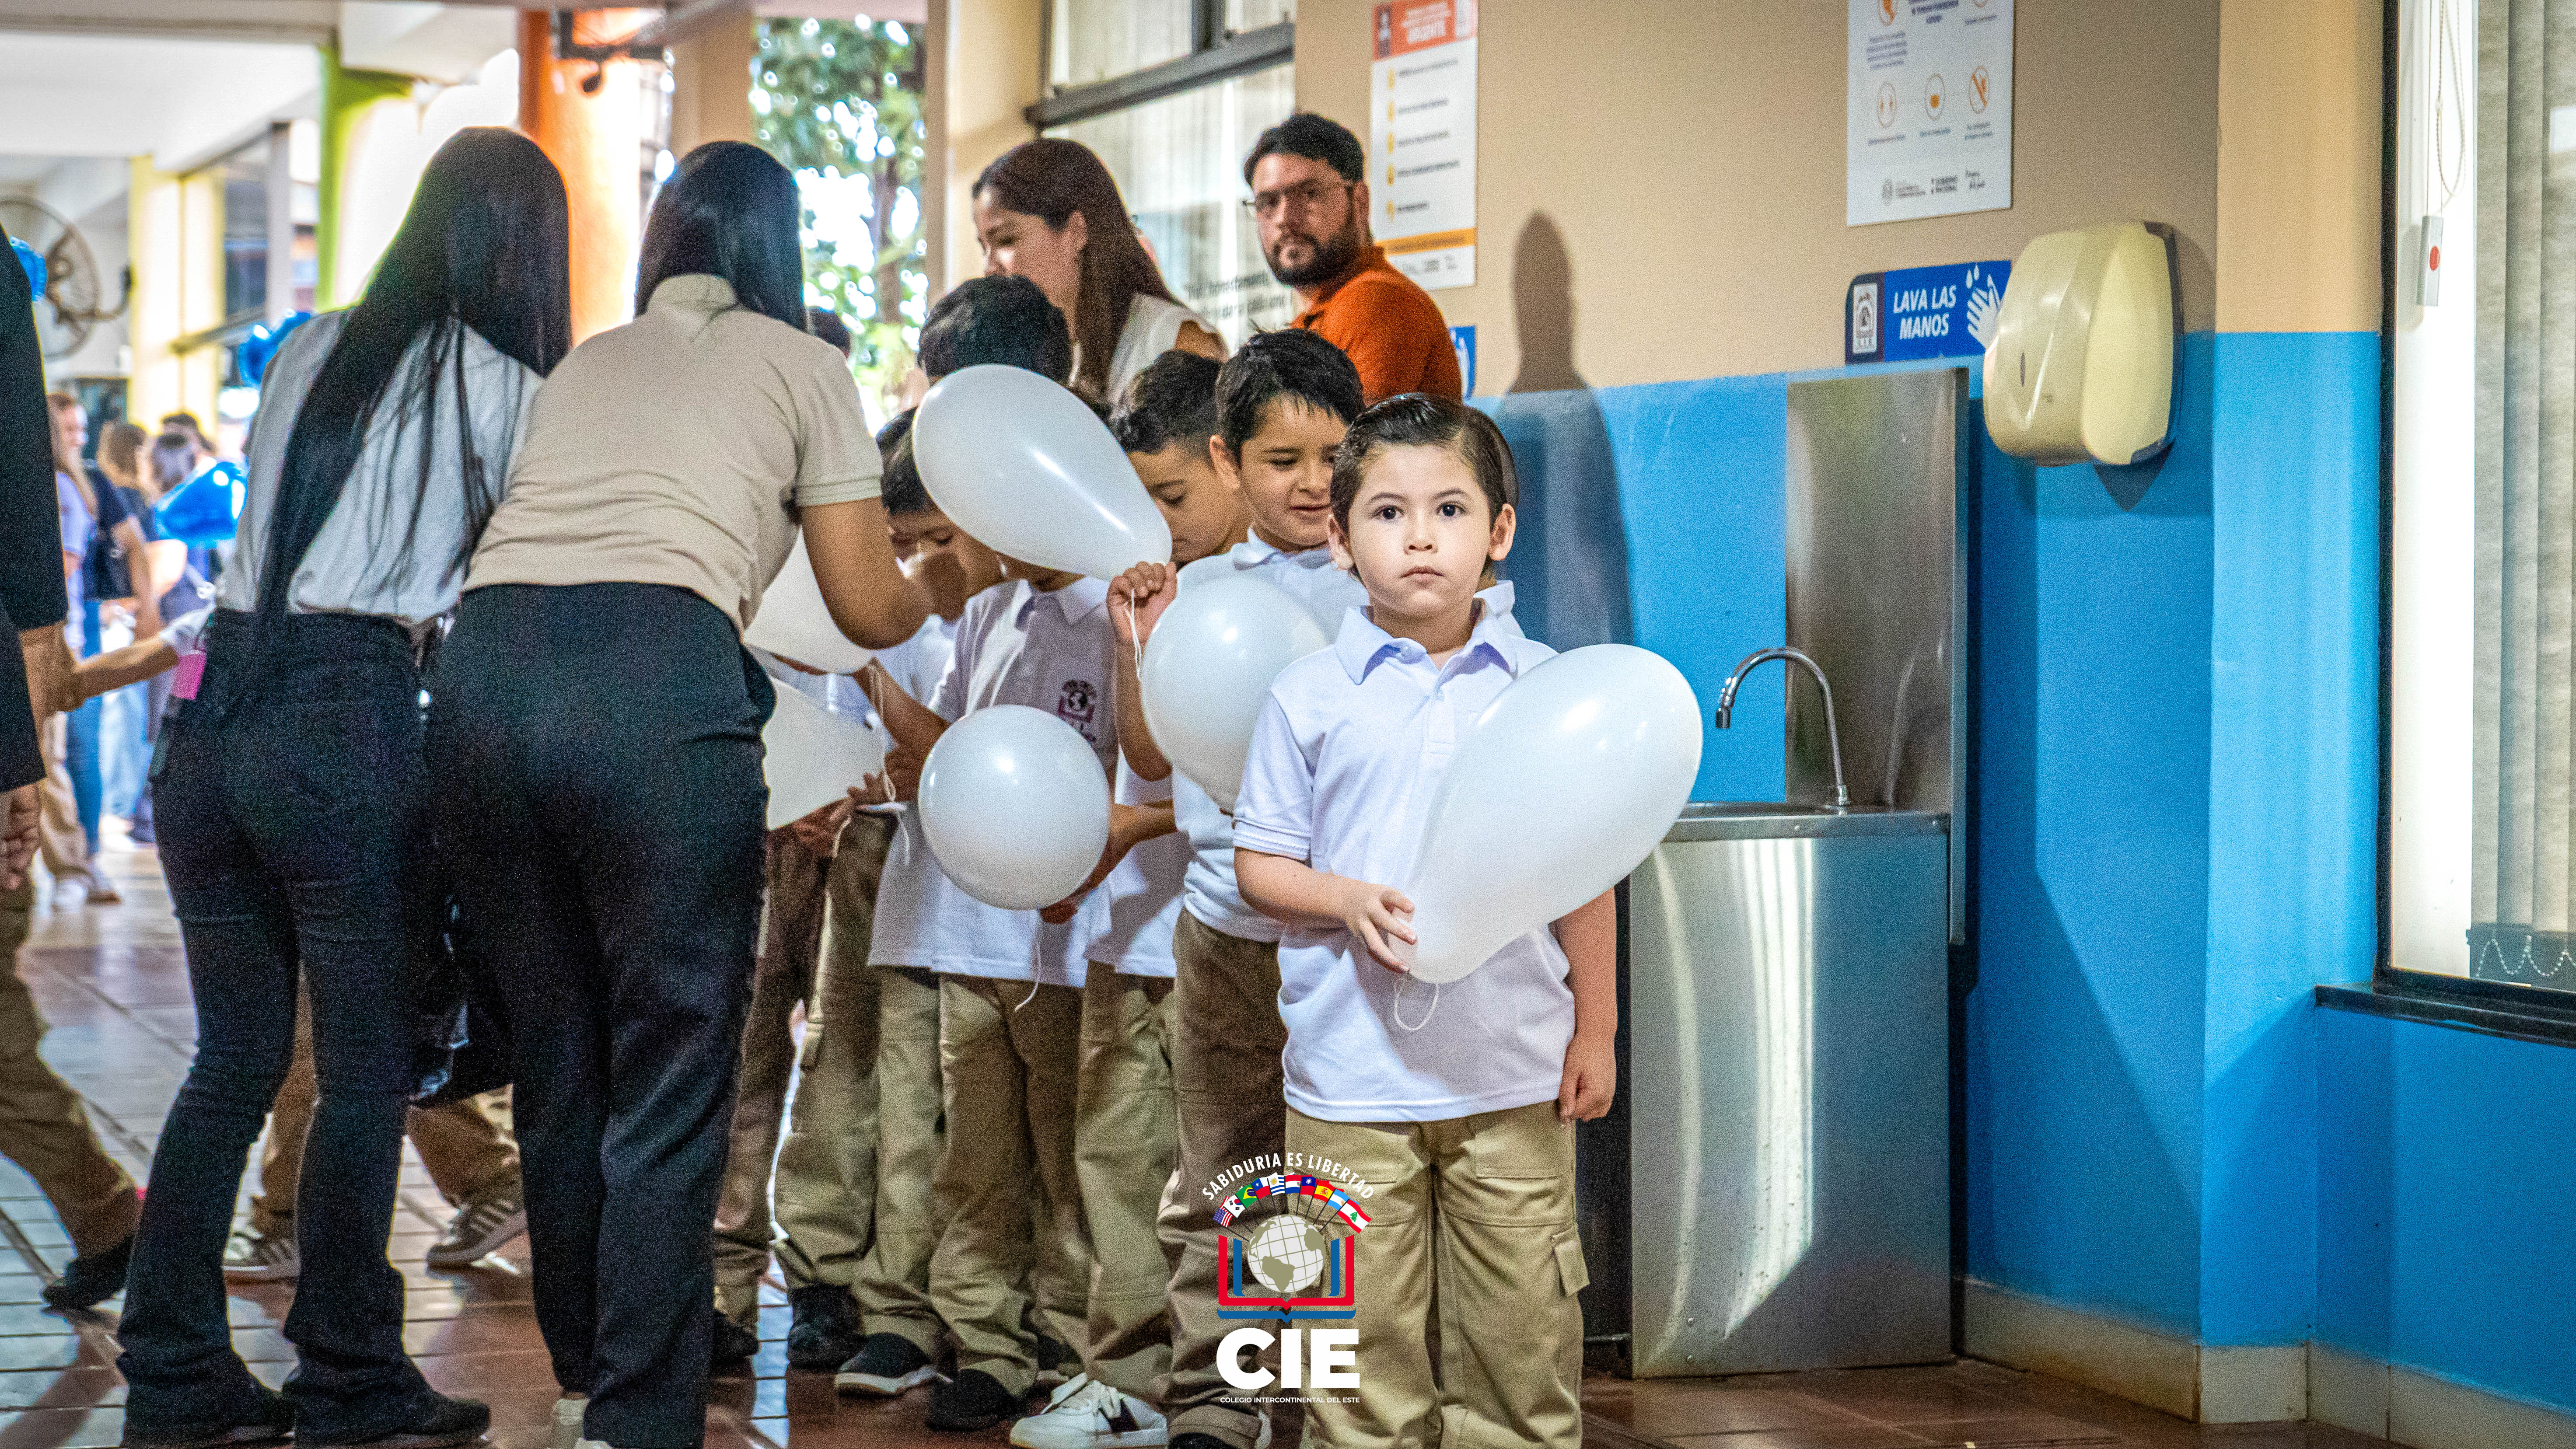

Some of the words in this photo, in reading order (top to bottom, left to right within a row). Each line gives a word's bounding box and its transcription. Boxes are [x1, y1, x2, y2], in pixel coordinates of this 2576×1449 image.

[1893, 290, 1928, 314] LAVA
[1932, 284, 1957, 309] LAS
[1900, 313, 1950, 340] MANOS
